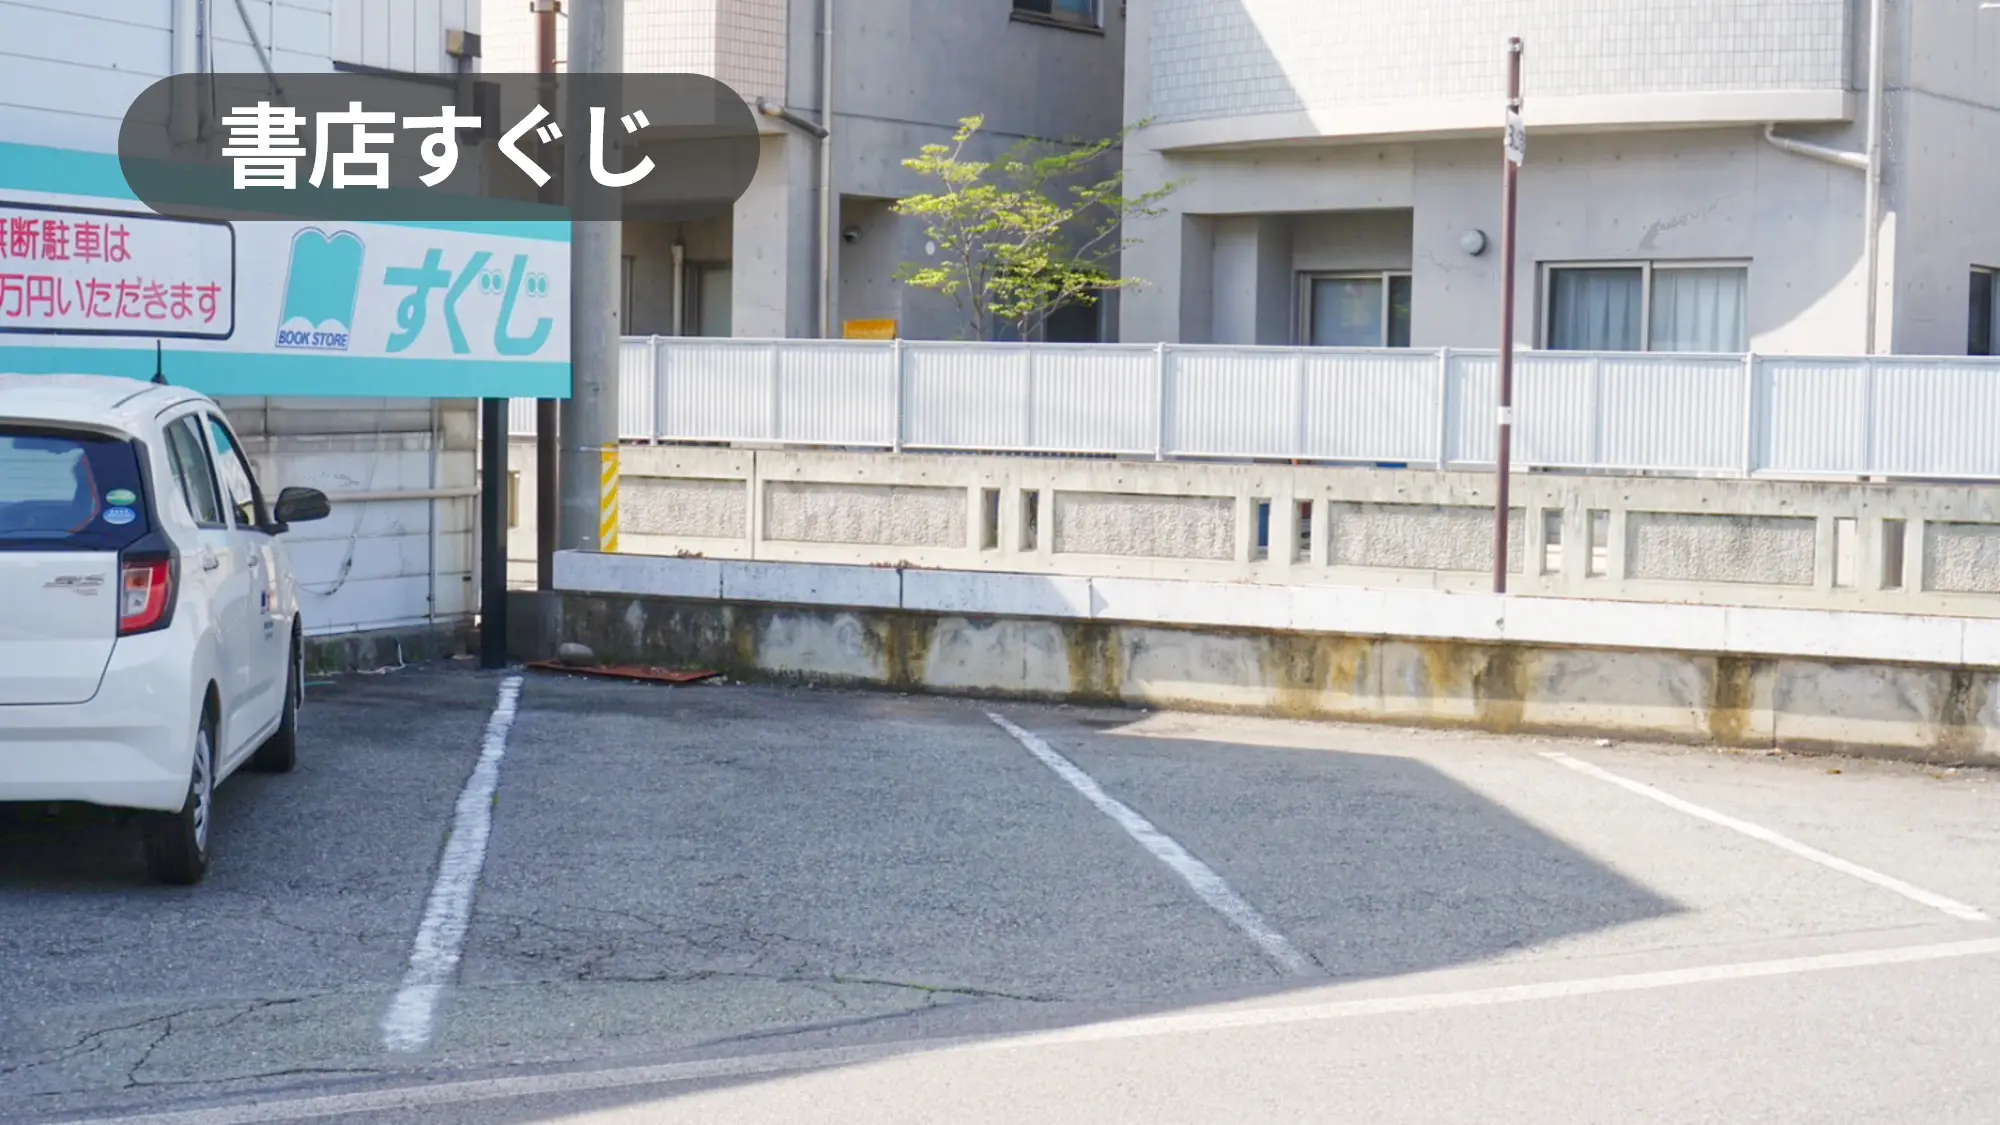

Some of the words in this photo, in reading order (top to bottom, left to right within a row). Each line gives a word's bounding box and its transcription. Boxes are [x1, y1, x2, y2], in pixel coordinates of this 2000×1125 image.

[0, 216, 131, 263] 断駐車は
[383, 248, 553, 356] すぐじ
[278, 330, 311, 345] BOOK
[311, 332, 349, 347] STORE
